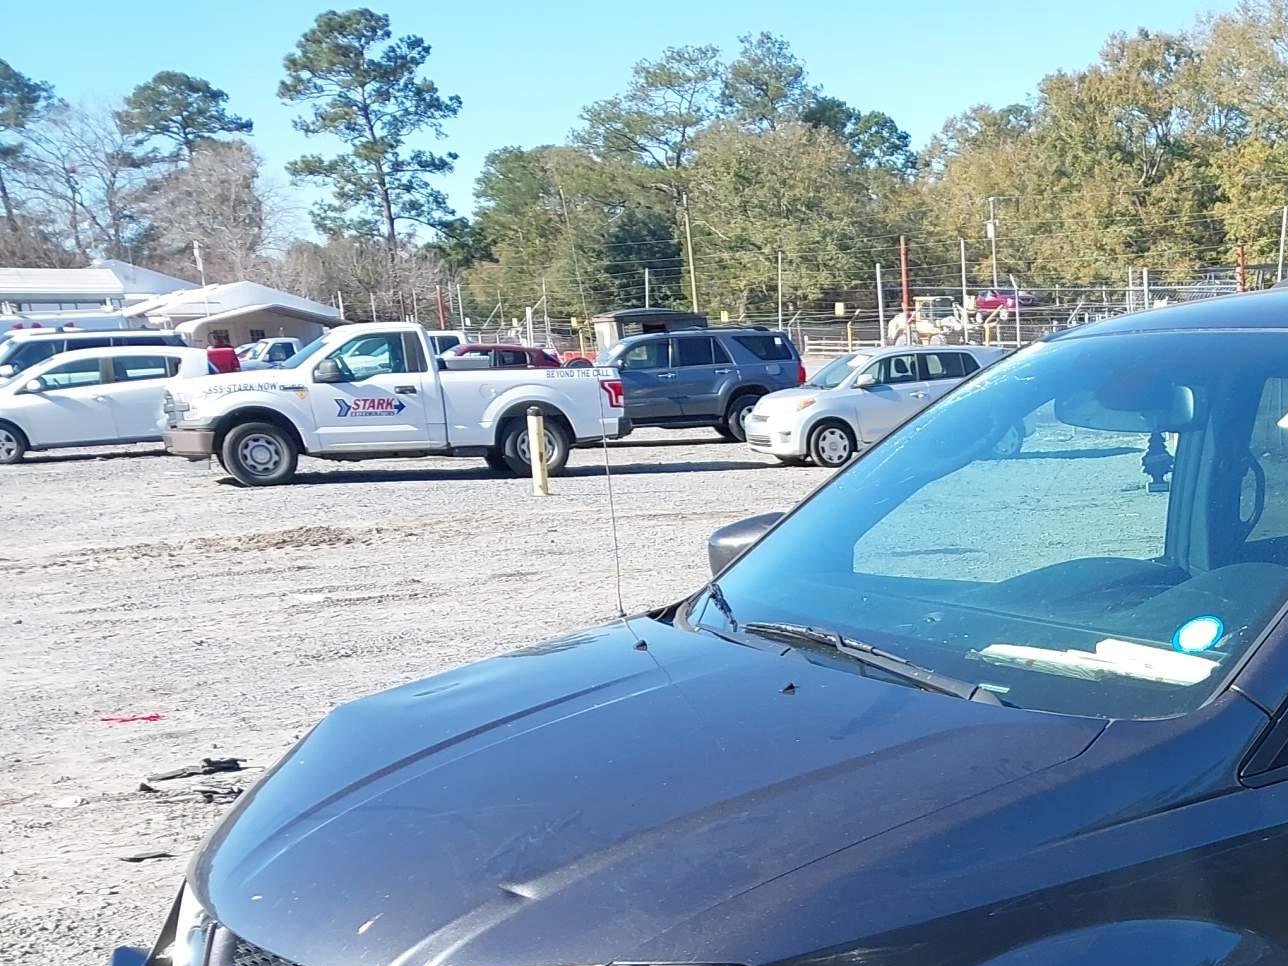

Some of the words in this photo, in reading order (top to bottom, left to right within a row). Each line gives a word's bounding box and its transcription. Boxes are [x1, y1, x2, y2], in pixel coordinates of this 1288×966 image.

[546, 370, 575, 378] BEYOND
[576, 369, 591, 377] THE
[592, 368, 612, 377] CALL
[351, 398, 395, 410] STARK
